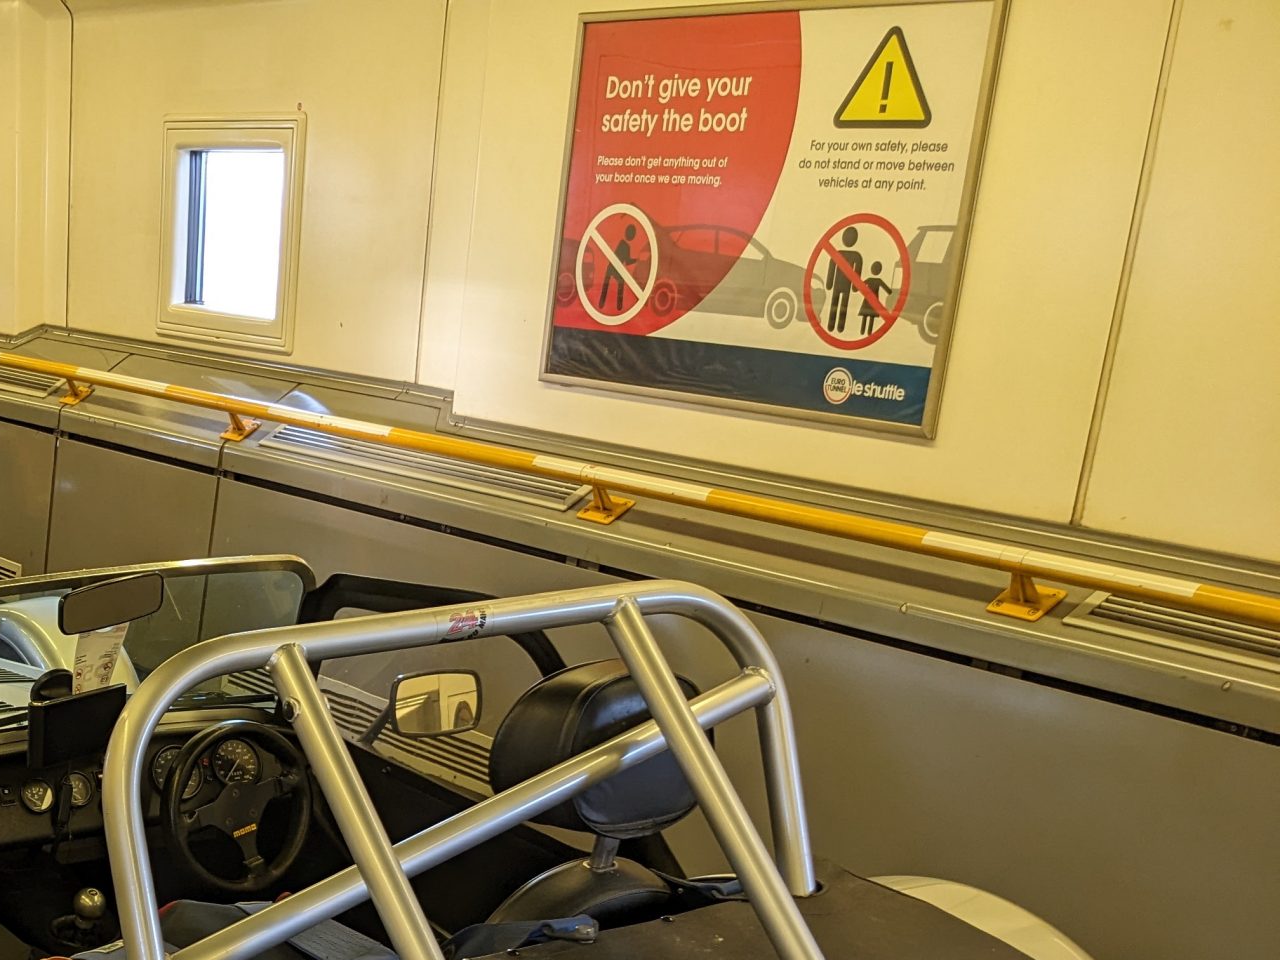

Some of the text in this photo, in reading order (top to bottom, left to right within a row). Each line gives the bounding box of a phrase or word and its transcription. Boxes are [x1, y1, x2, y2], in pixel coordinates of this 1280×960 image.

[606, 74, 752, 103] Don't give your
[601, 107, 748, 137] safety the boot
[810, 140, 948, 154] For your own safety, please
[597, 155, 729, 170] Please don't get anything out of
[798, 158, 955, 172] do not stand or move between
[595, 172, 722, 187] your boot once we are moving.
[818, 177, 926, 192] vehicles at any point.
[827, 384, 847, 393] TUNNEL
[831, 378, 846, 386] EURO
